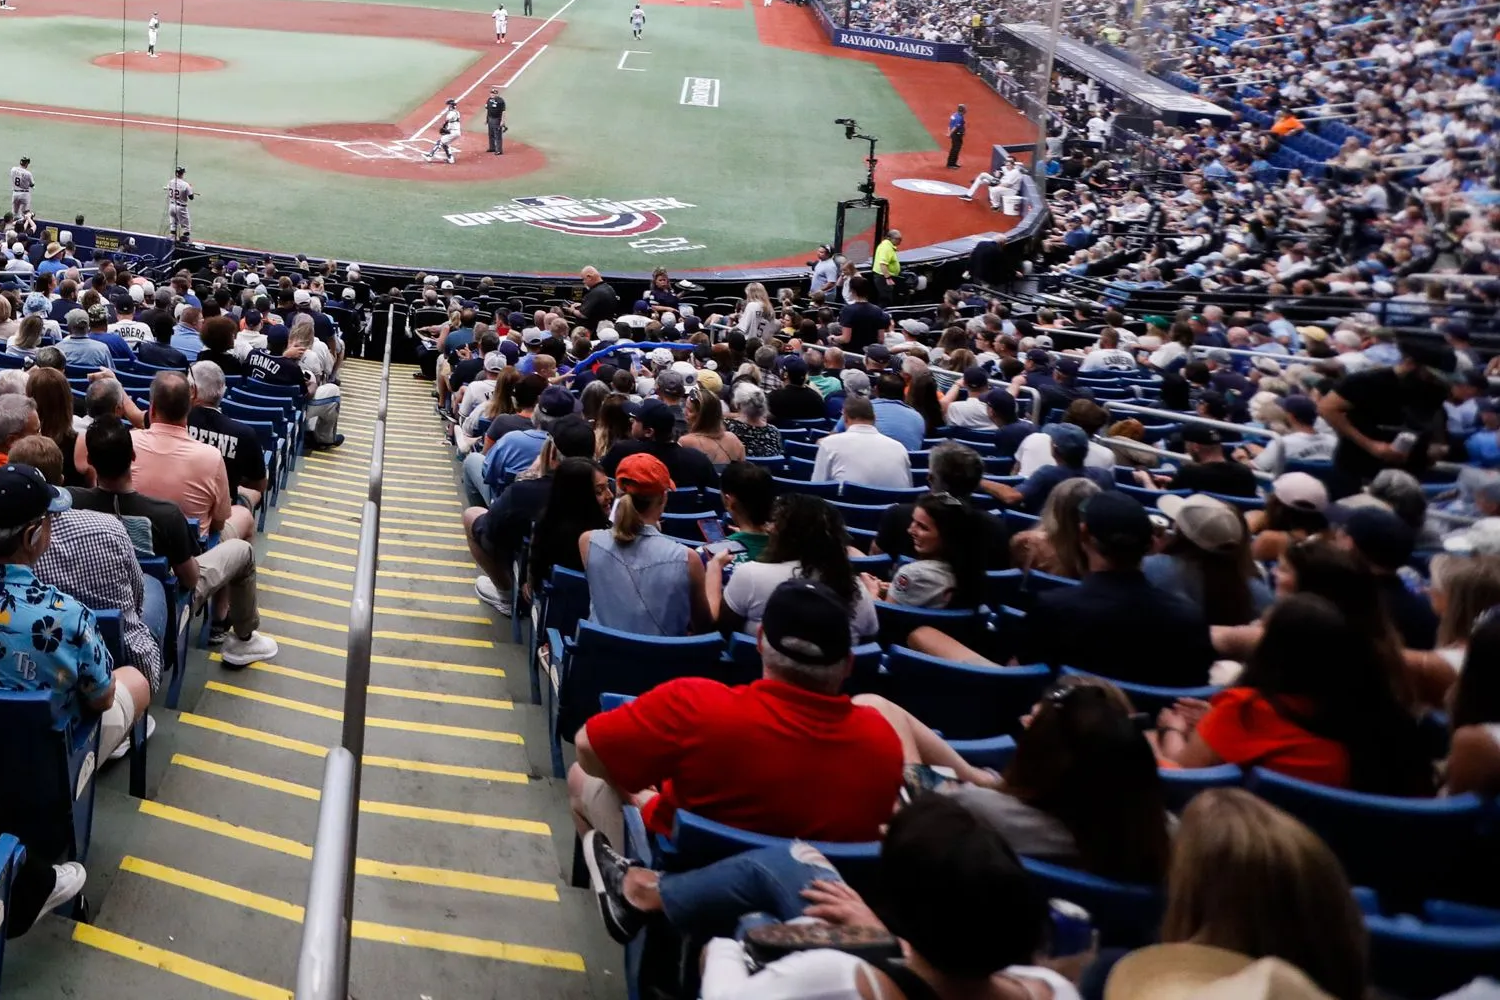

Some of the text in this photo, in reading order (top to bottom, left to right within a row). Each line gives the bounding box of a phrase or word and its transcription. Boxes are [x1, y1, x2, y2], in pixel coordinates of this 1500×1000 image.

[841, 34, 934, 56] RAYMOND JAMES
[14, 178, 21, 187] 8
[169, 188, 180, 199] 32
[443, 196, 697, 227] OPENING WEEK
[250, 354, 280, 375] FRANCO
[189, 426, 238, 459] REENE
[12, 651, 37, 681] TB
